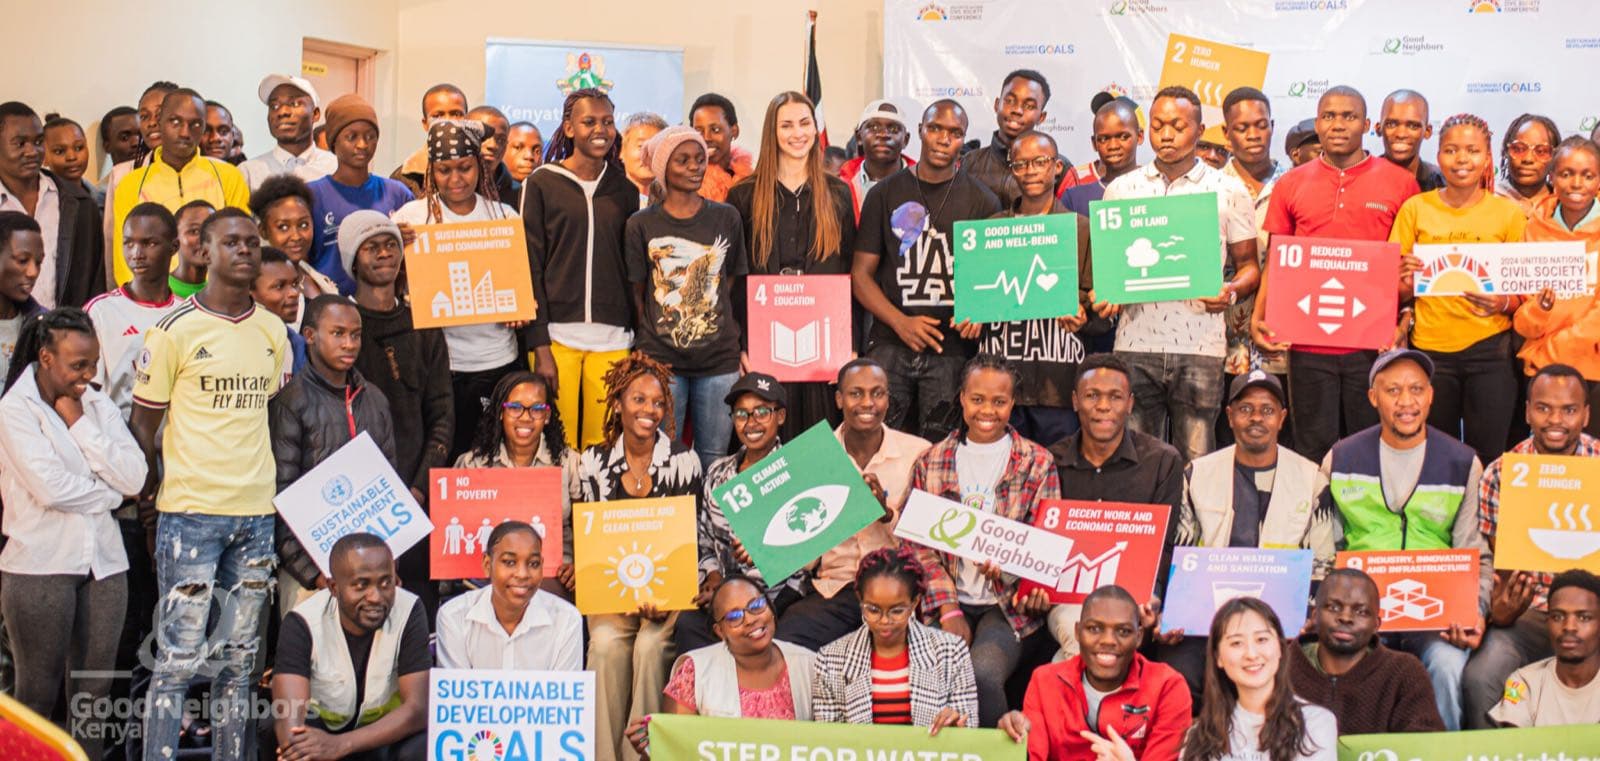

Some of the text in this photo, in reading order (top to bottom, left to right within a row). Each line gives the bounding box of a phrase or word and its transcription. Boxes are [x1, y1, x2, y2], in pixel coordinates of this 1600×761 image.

[1310, 0, 1347, 10] GOALS
[1402, 35, 1425, 43] Good
[1039, 45, 1074, 55] GOALS
[1172, 42, 1186, 63] 2
[1193, 45, 1212, 57] ZERO
[1402, 43, 1444, 52] Neighbors
[1190, 57, 1220, 72] HUNGER
[947, 87, 983, 97] GOALS
[1503, 82, 1541, 93] GOALS
[1129, 205, 1147, 216] LIFE
[1096, 207, 1122, 230] 15
[1130, 215, 1168, 228] ON LAND
[434, 226, 515, 241] SUSTAINABLE CITIES
[984, 223, 1045, 237] GOOD HEALTH
[436, 239, 511, 254] AND COMMUNITIES
[962, 228, 977, 251] 3
[985, 234, 1058, 250] AND WELL-BEING
[1277, 243, 1303, 268] 10
[1311, 246, 1352, 258] REDUCED
[1309, 258, 1369, 273] INEQUALITIES
[1500, 257, 1518, 265] 2024
[1550, 255, 1584, 264] NATIONS
[1500, 266, 1584, 278] CIVIL SOCIETY
[755, 283, 768, 306] 4
[774, 283, 805, 294] QUALITY
[774, 296, 816, 306] EDUCATION
[200, 373, 271, 392] Emirate
[212, 394, 233, 409] FLY
[752, 456, 788, 484] CLIMATE
[1511, 462, 1530, 487] 2
[1539, 464, 1567, 475] ZERO
[437, 477, 448, 500] 1
[456, 476, 470, 487] NO
[760, 470, 791, 496] ACTION
[1538, 477, 1582, 490] HUNGER
[456, 489, 498, 500] POVERTY
[722, 483, 753, 513] 13
[311, 478, 391, 541] SUSTAINABLE
[603, 505, 675, 520] AFFORDABLE AND
[1068, 508, 1153, 521] DECENT WORK AND
[582, 511, 594, 535] 7
[1043, 507, 1061, 529] 8
[603, 520, 663, 533] CLEAN ENERGY
[980, 518, 1029, 546] Good
[1066, 522, 1156, 535] ECONOMIC GROWTH
[971, 536, 1062, 579] Neighbors
[1182, 553, 1199, 572] 6
[1208, 554, 1275, 563] CLEAN WATER
[1367, 554, 1472, 564] INDUSTRY, INNOVATION
[1207, 564, 1288, 574] AND SANITATION
[1366, 564, 1471, 574] AND INFRASTRUCTURE
[437, 679, 585, 701] SUSTAINABLE
[436, 704, 585, 725] DEVELOPMENT
[435, 729, 586, 761] GOALS
[697, 740, 781, 761] STEP
